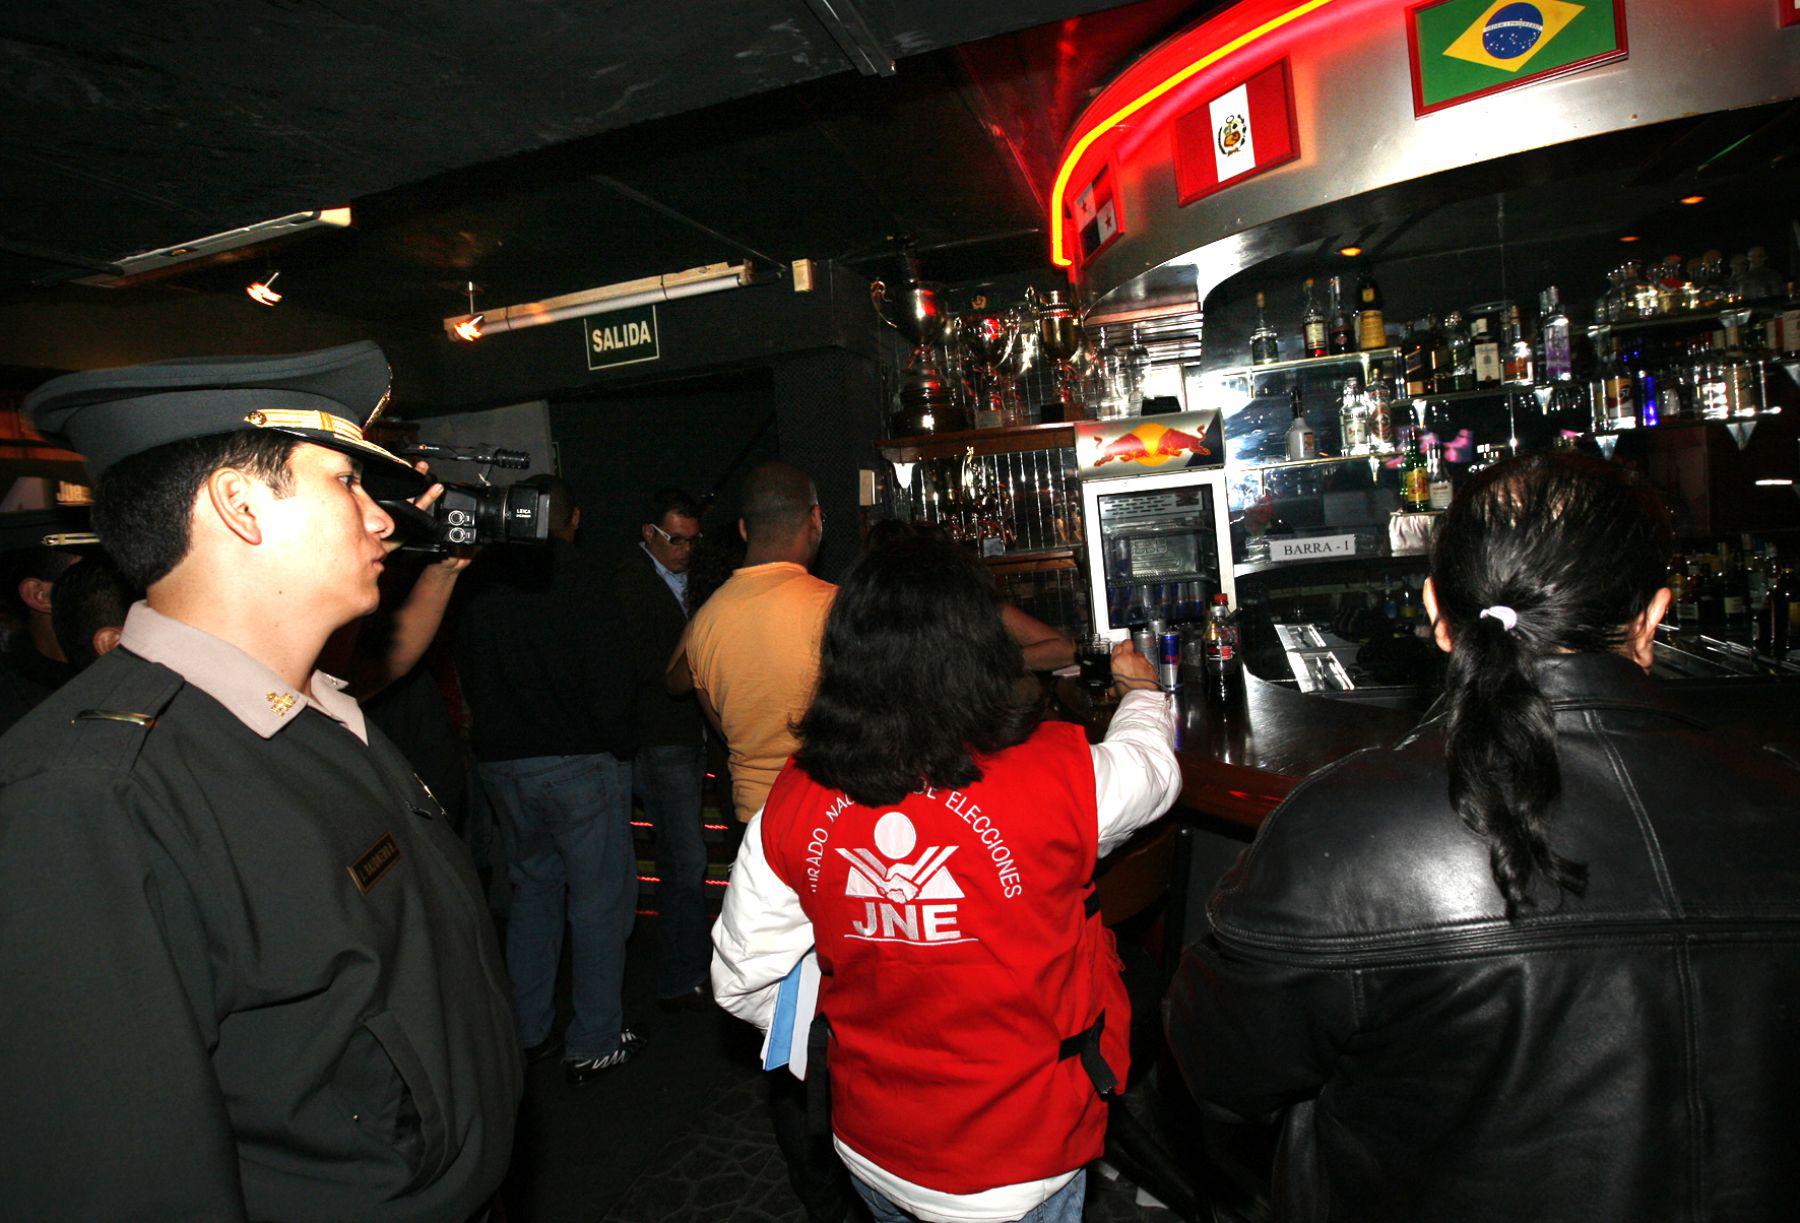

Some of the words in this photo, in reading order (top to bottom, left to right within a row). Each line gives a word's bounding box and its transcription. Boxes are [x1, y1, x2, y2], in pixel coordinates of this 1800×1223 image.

[592, 320, 652, 353] SALIDA
[1284, 542, 1332, 556] BARRA
[945, 790, 1022, 899] ELECCIONES
[852, 901, 962, 941] JNE
